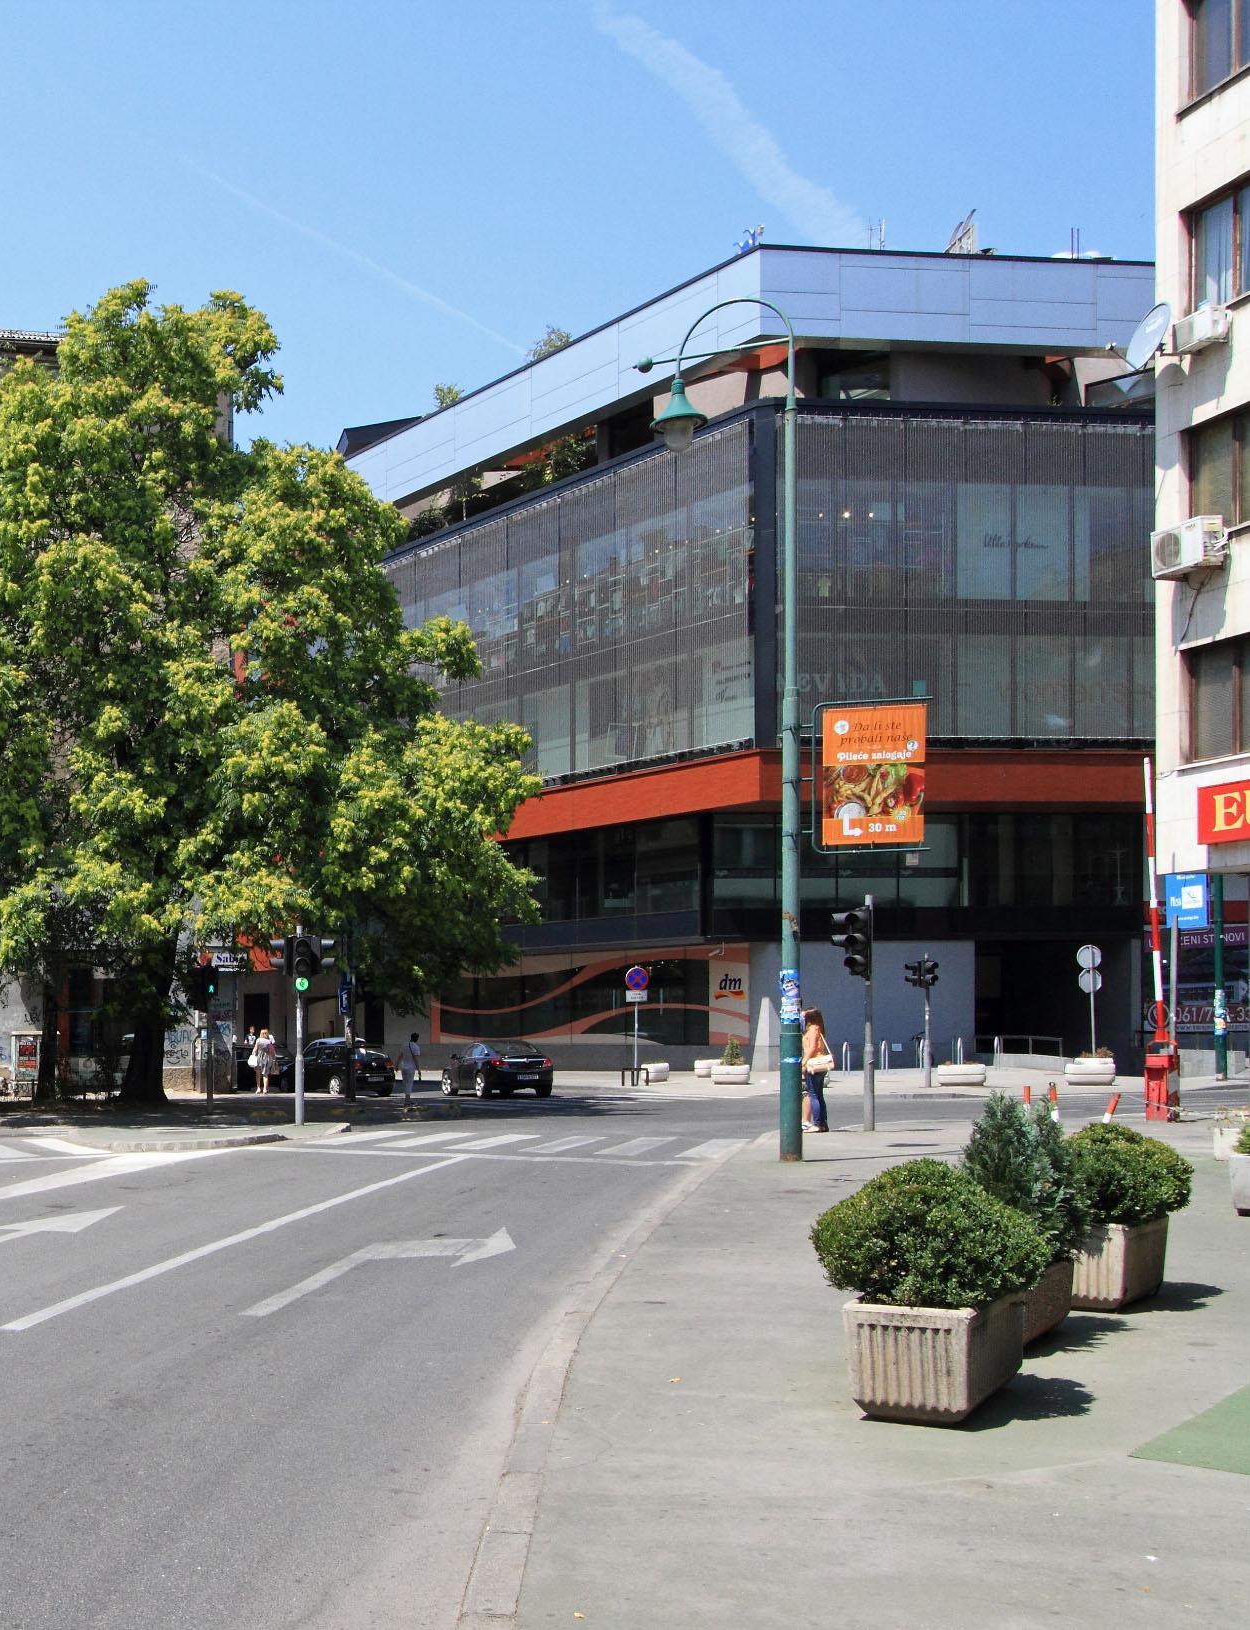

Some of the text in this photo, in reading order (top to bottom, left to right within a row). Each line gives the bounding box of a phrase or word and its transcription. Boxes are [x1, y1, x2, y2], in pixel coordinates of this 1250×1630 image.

[854, 720, 902, 732] Da li ste
[839, 733, 882, 747] probali
[837, 749, 912, 762] Pileće zalogaje
[868, 823, 897, 832] 30 m
[1203, 932, 1245, 944] STNOVI
[719, 974, 742, 991] dm
